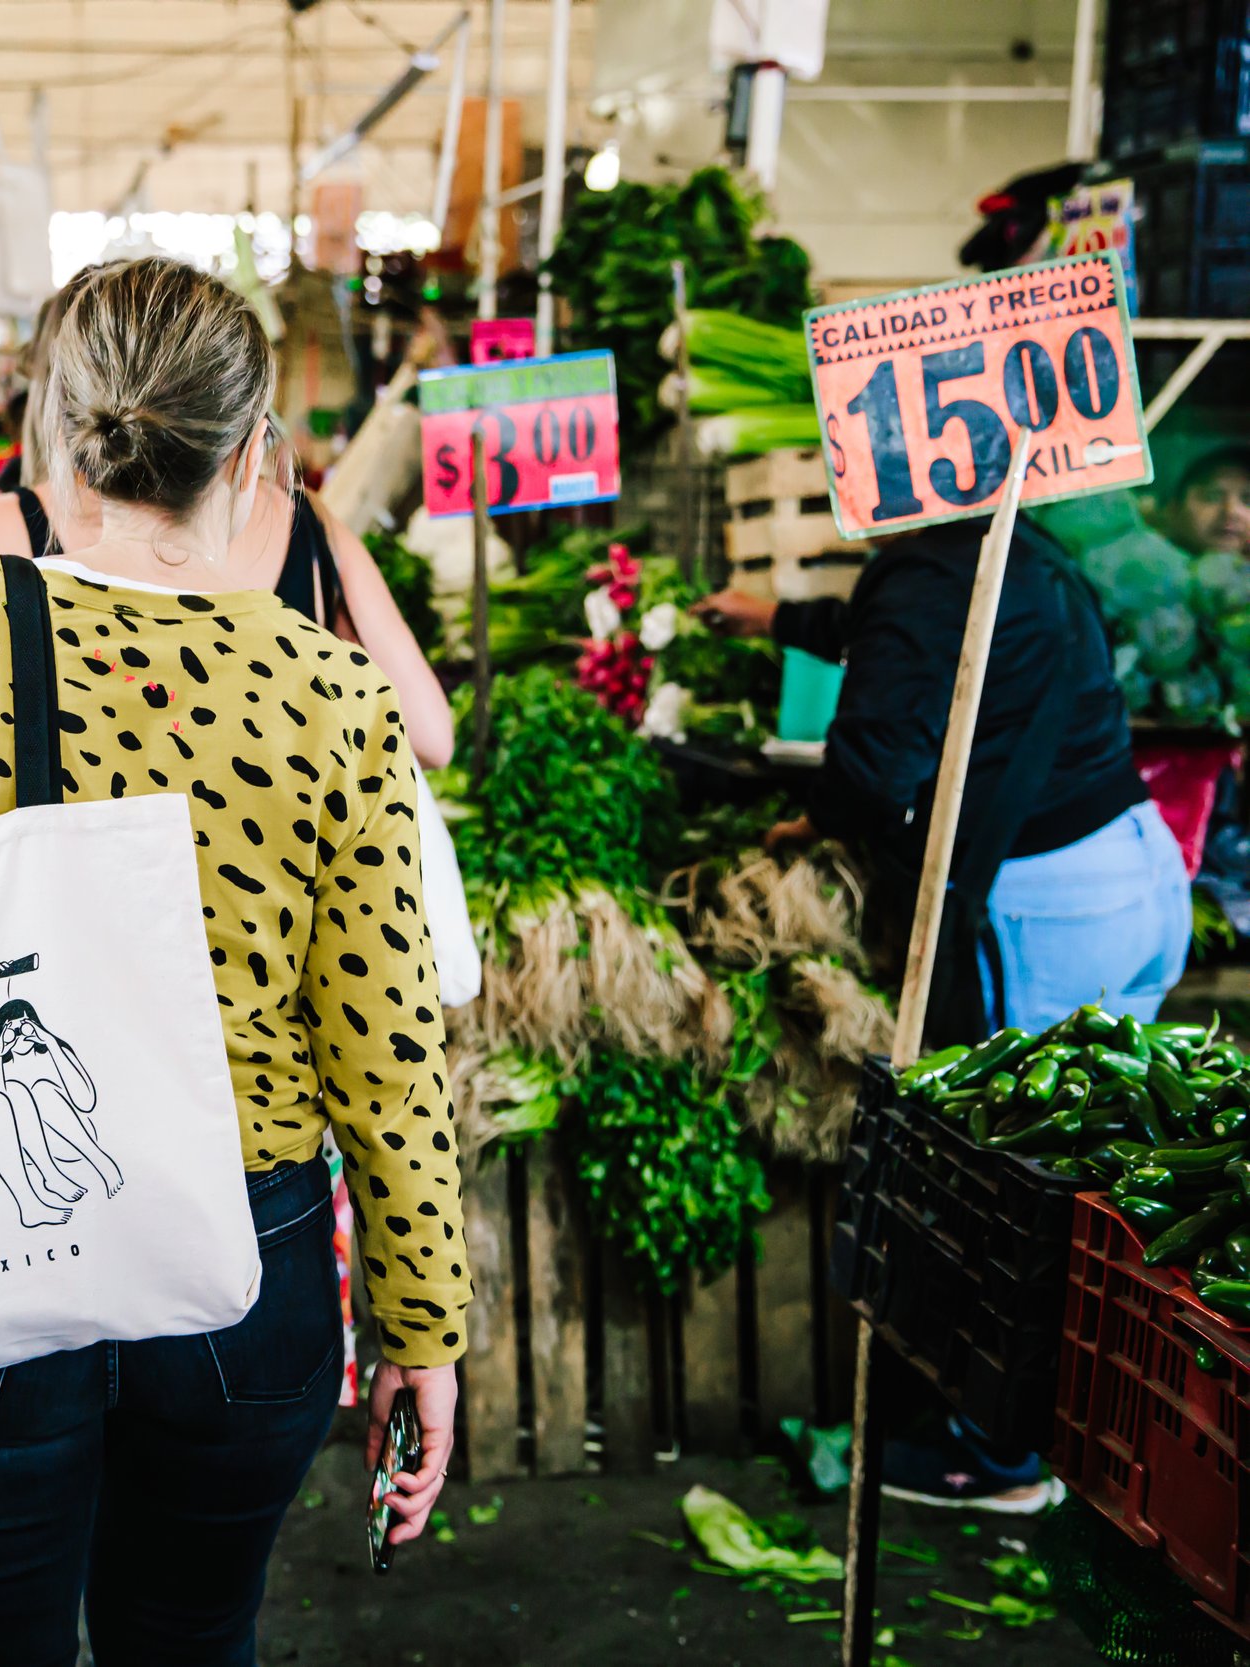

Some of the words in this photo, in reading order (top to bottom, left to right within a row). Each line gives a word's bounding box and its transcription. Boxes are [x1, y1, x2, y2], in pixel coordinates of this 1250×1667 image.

[822, 306, 947, 348] CALIDAD
[960, 300, 975, 319] Y
[989, 275, 1101, 315] PRECIO
